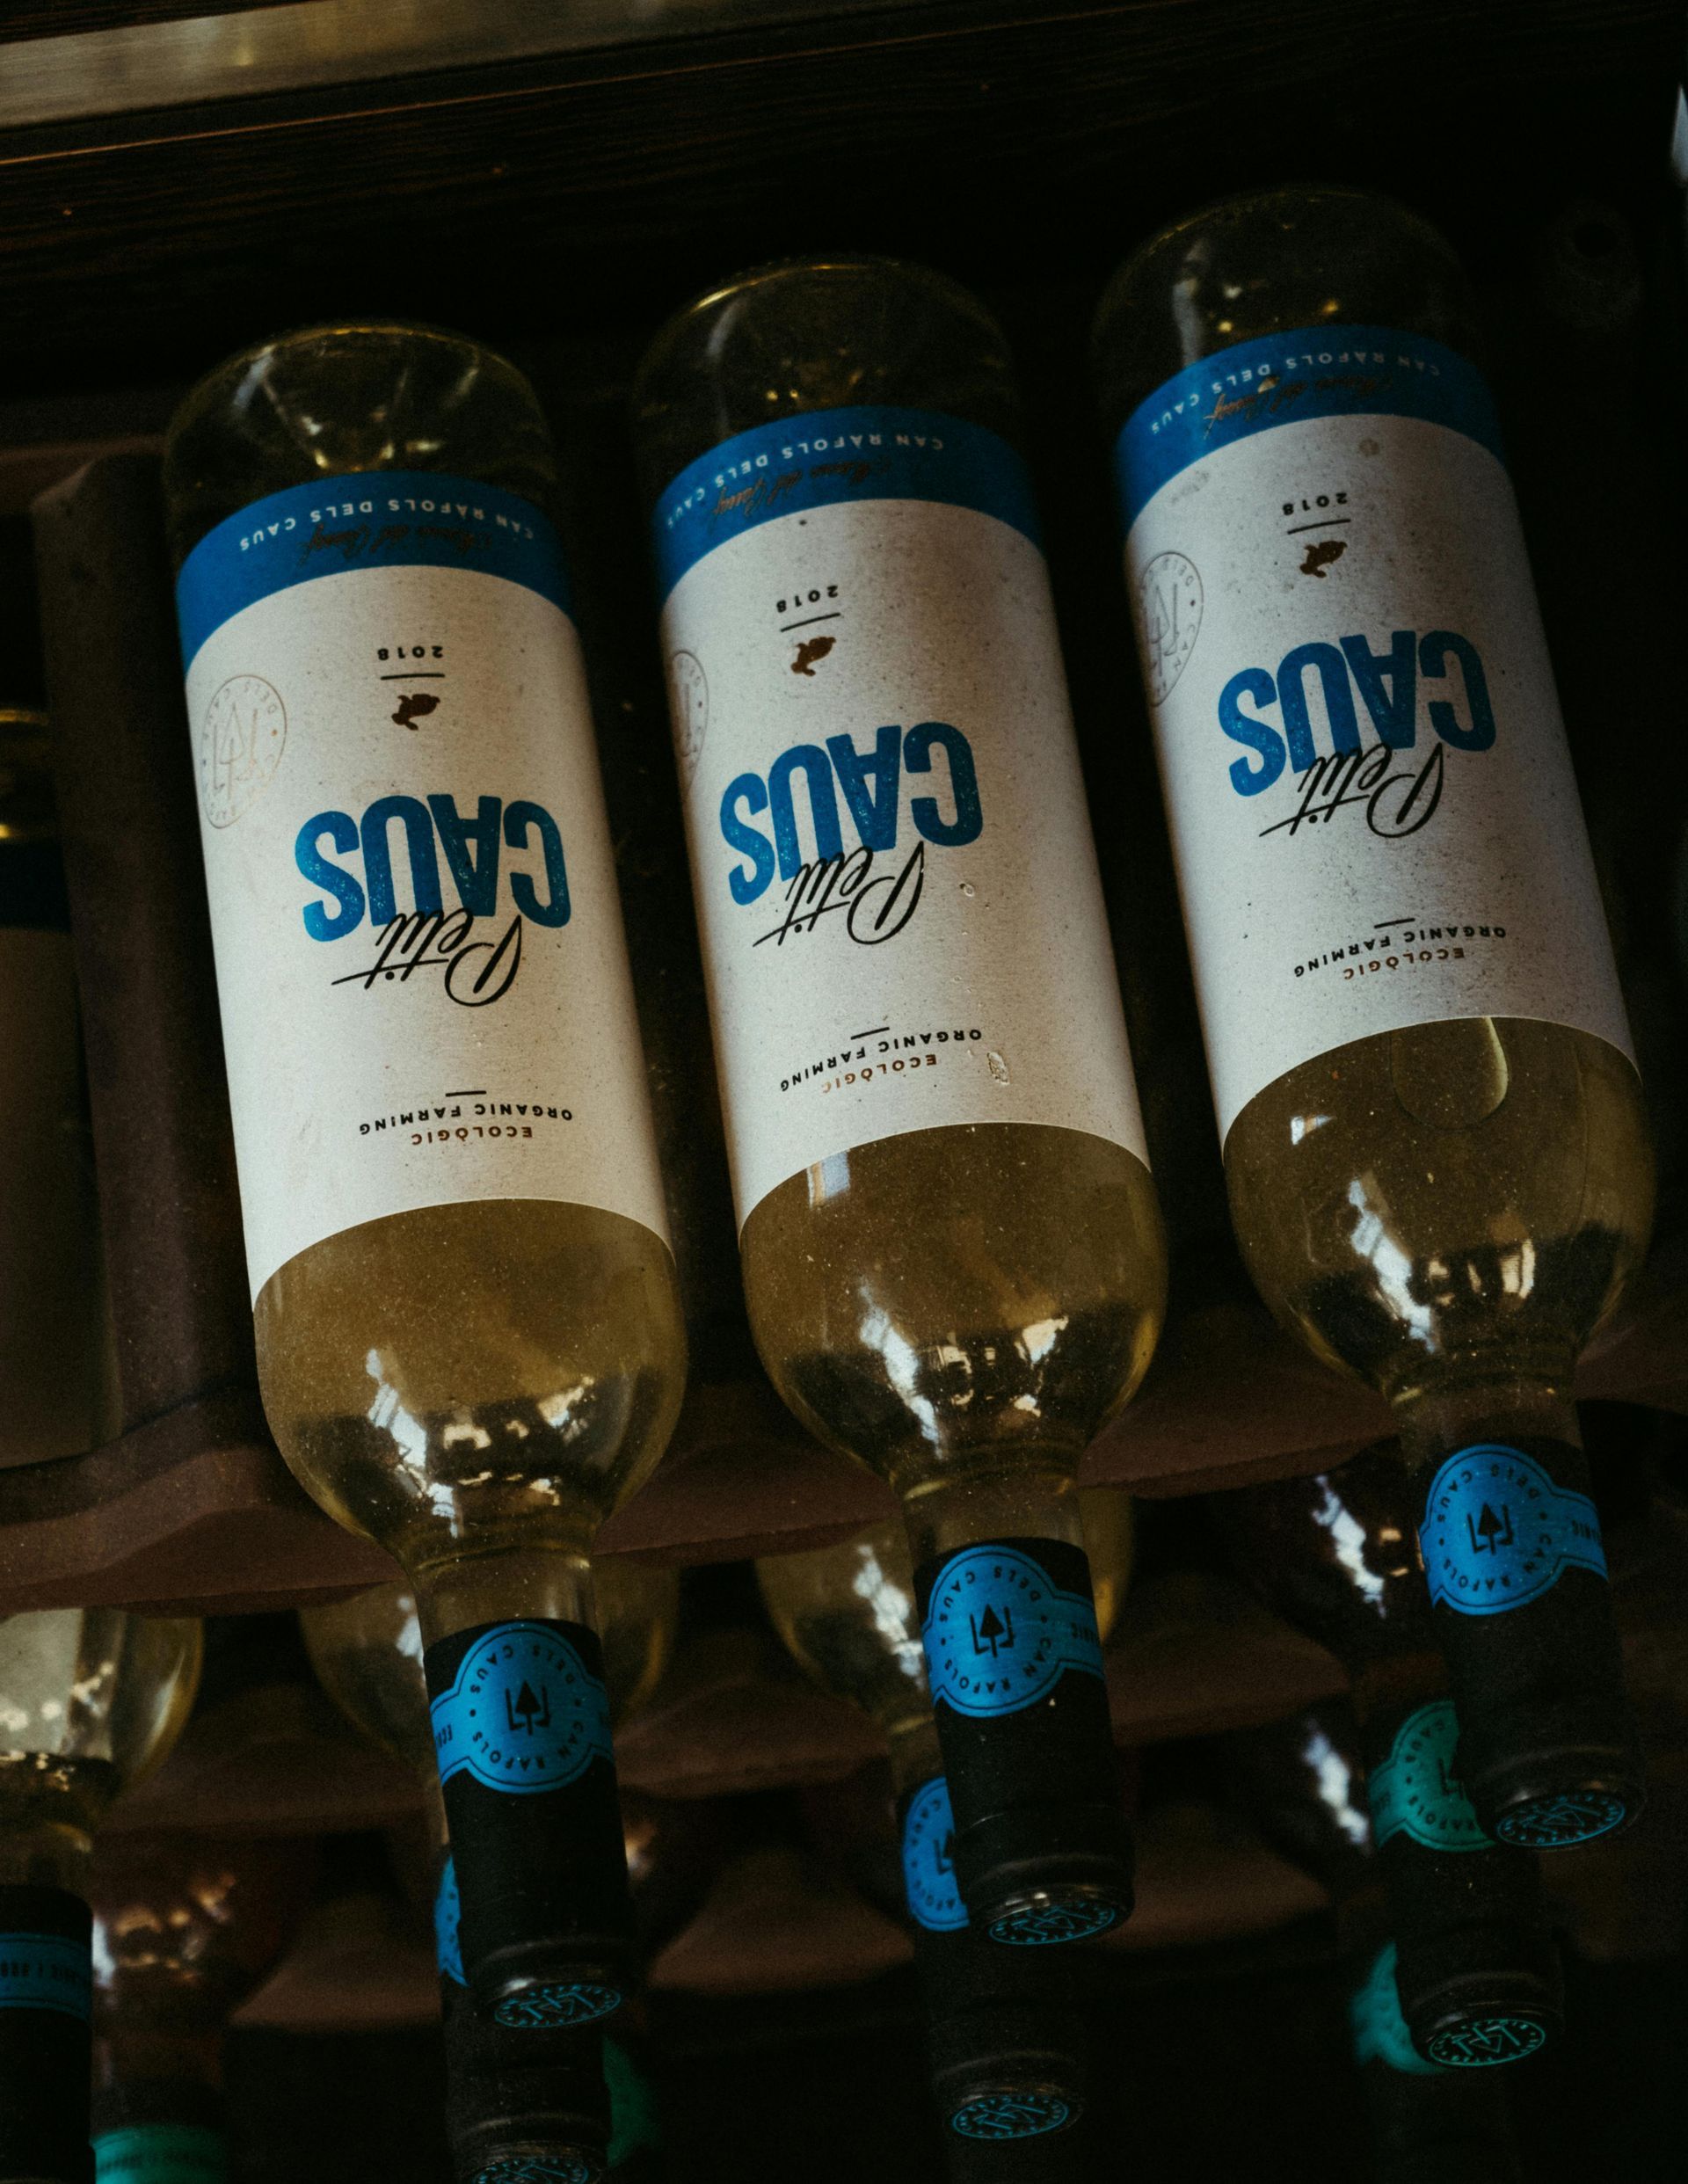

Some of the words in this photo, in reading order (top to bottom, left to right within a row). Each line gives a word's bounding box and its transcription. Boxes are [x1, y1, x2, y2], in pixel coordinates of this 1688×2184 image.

[1210, 363, 1272, 396] DELS
[1396, 354, 1441, 378] CAN
[1148, 392, 1200, 437] CAUS
[894, 433, 944, 452] CAN
[712, 453, 769, 489] DELS
[309, 499, 374, 524] DELS
[665, 486, 708, 530] CAUS
[1283, 492, 1347, 515] 2018
[237, 515, 298, 553] CAUS
[776, 586, 838, 613] 2018
[378, 646, 443, 660] 2018
[1219, 630, 1495, 796] CAUS
[1259, 743, 1444, 838] Petit
[720, 722, 983, 905] CAUS
[295, 795, 571, 942] CAUS
[753, 841, 924, 944] Petit
[1404, 926, 1506, 943] ORGANIC
[331, 908, 521, 1007] Petit
[1293, 935, 1391, 978] FARMING
[1342, 948, 1465, 980] ECOLÒGIC
[877, 1029, 982, 1052] ORGANIC
[779, 1047, 866, 1092] FARMING
[821, 1054, 936, 1094] ECOLÒGIC
[359, 1105, 462, 1135] FARMING
[474, 1103, 572, 1121] ORGANIC
[410, 1125, 533, 1146] ECOLÒGIC
[938, 1570, 976, 1624] CAUS
[469, 1645, 514, 1695] CAUS
